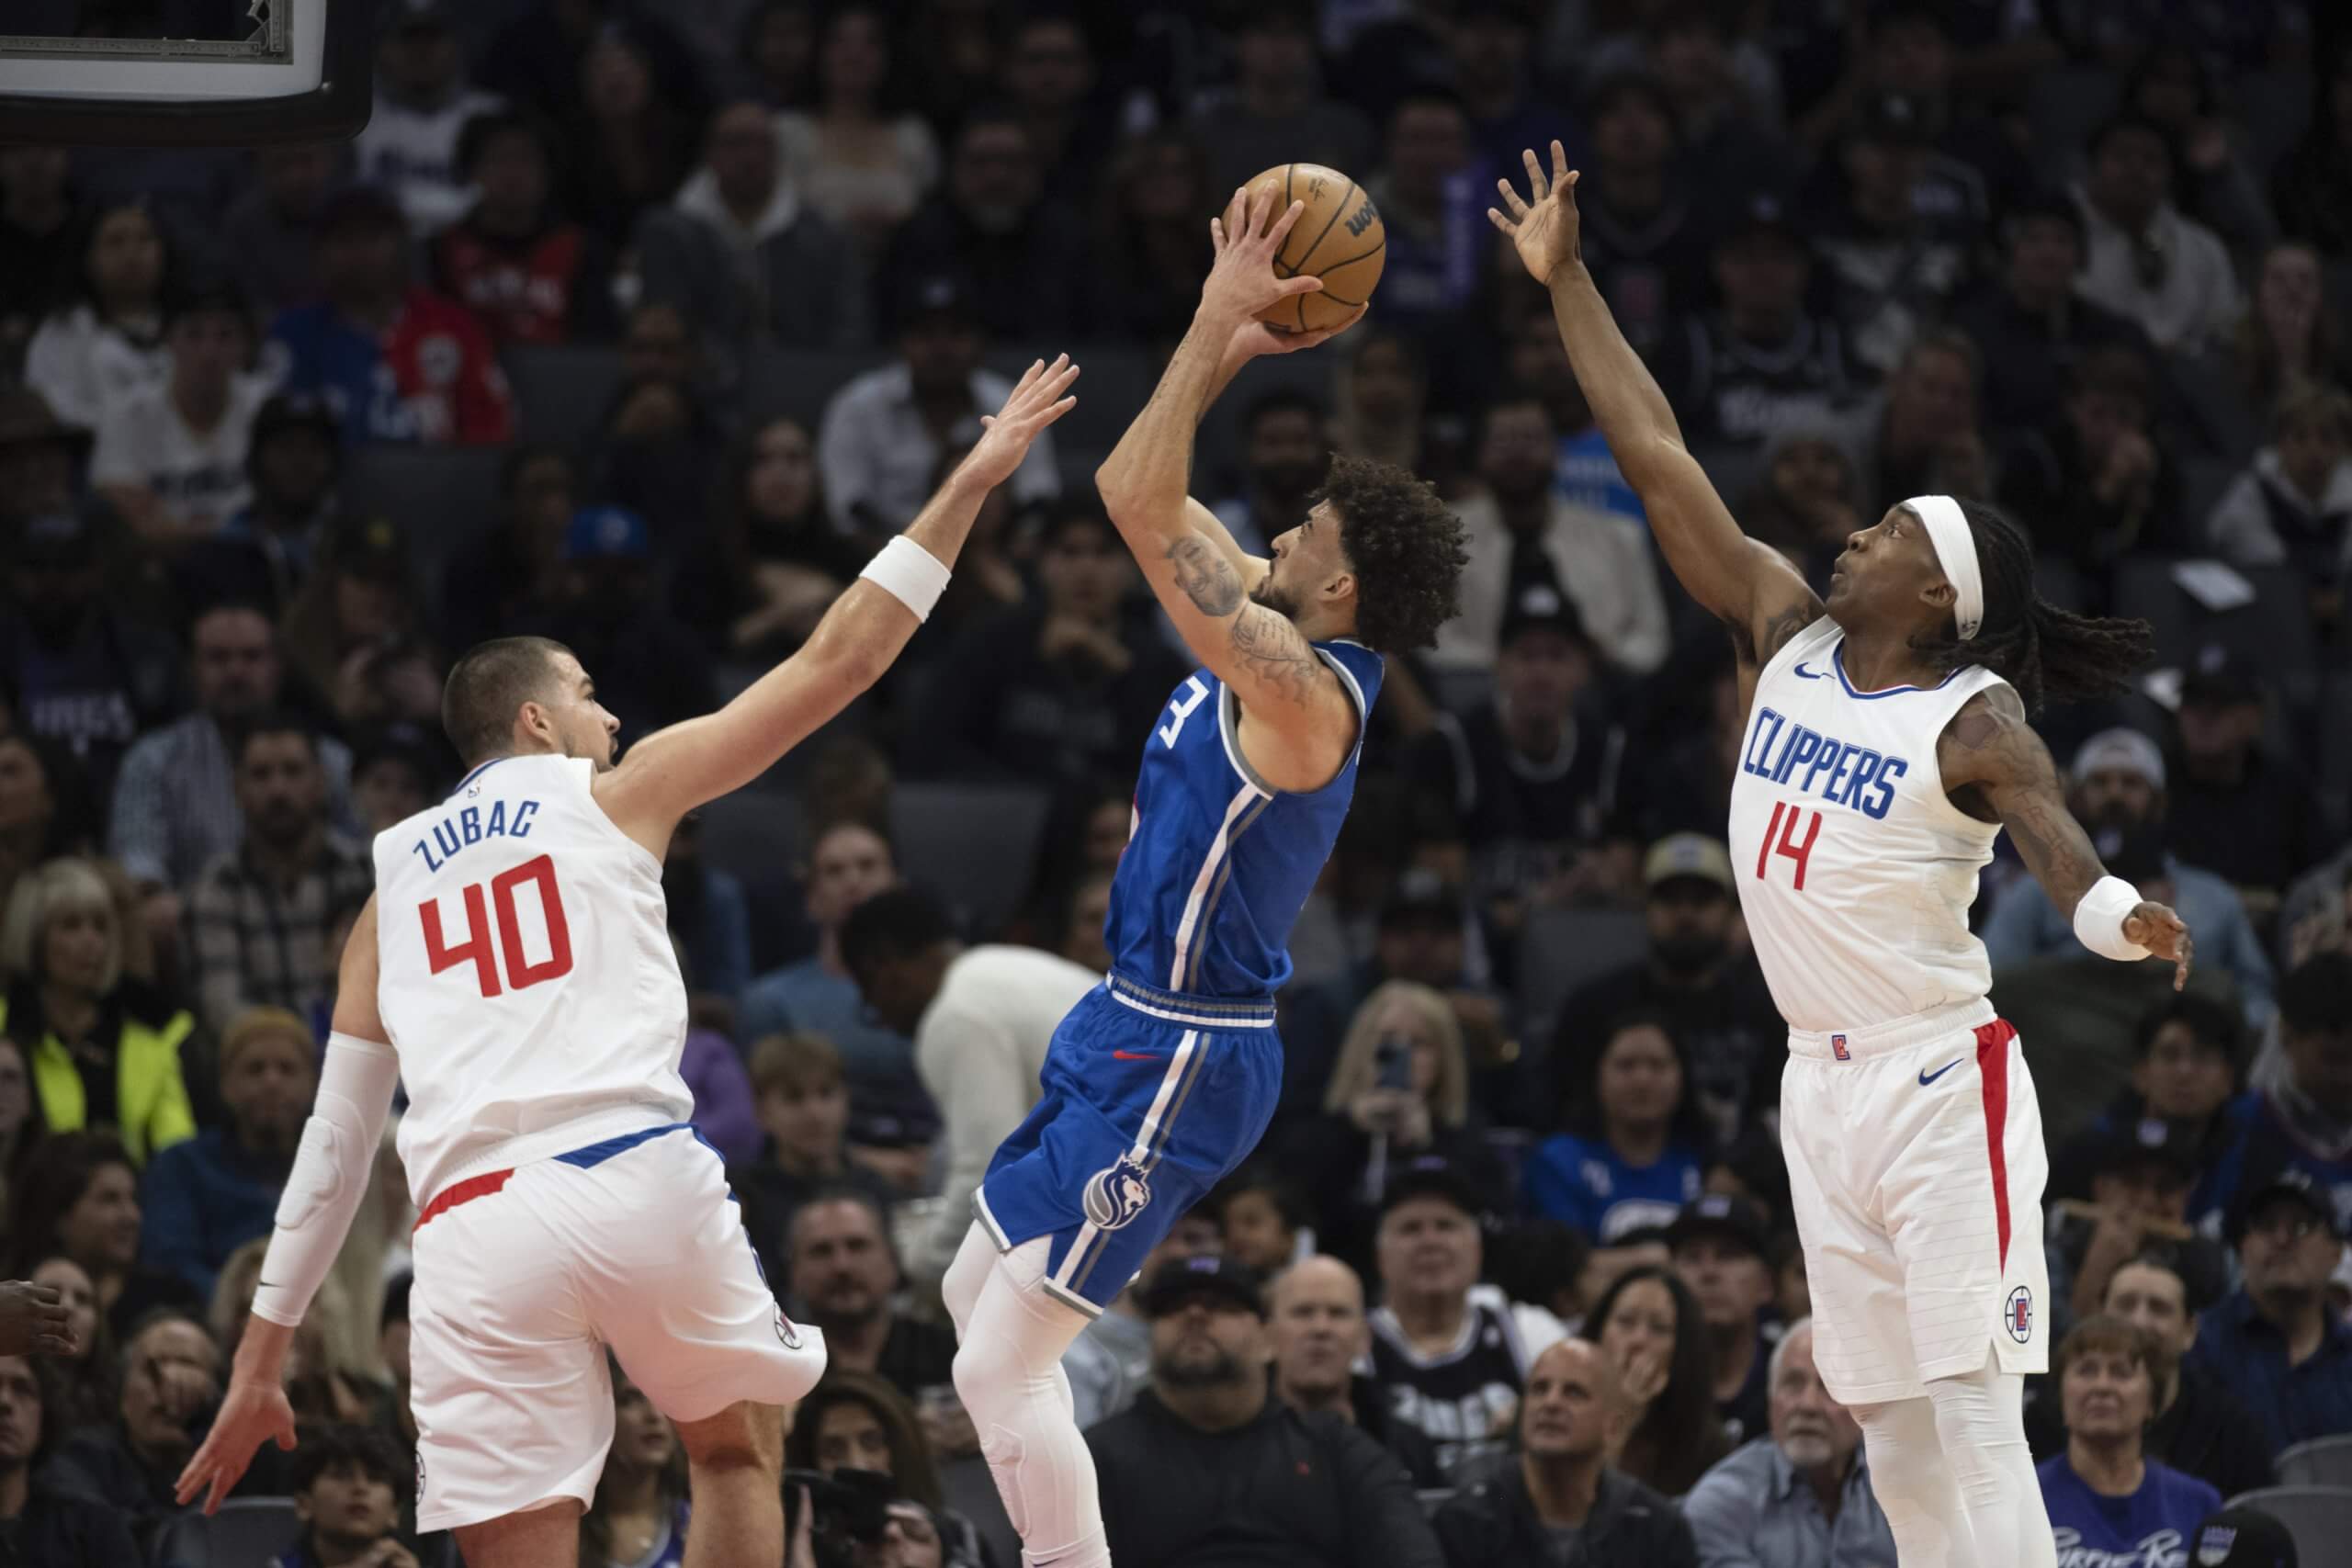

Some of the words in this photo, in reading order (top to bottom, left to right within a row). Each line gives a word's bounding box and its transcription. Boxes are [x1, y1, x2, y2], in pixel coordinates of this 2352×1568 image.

[1159, 675, 1210, 750] 3
[1744, 706, 1909, 820] CLIPPERS
[413, 800, 540, 873] ZUBAC
[1756, 800, 1823, 892] 14
[418, 853, 574, 998] 40
